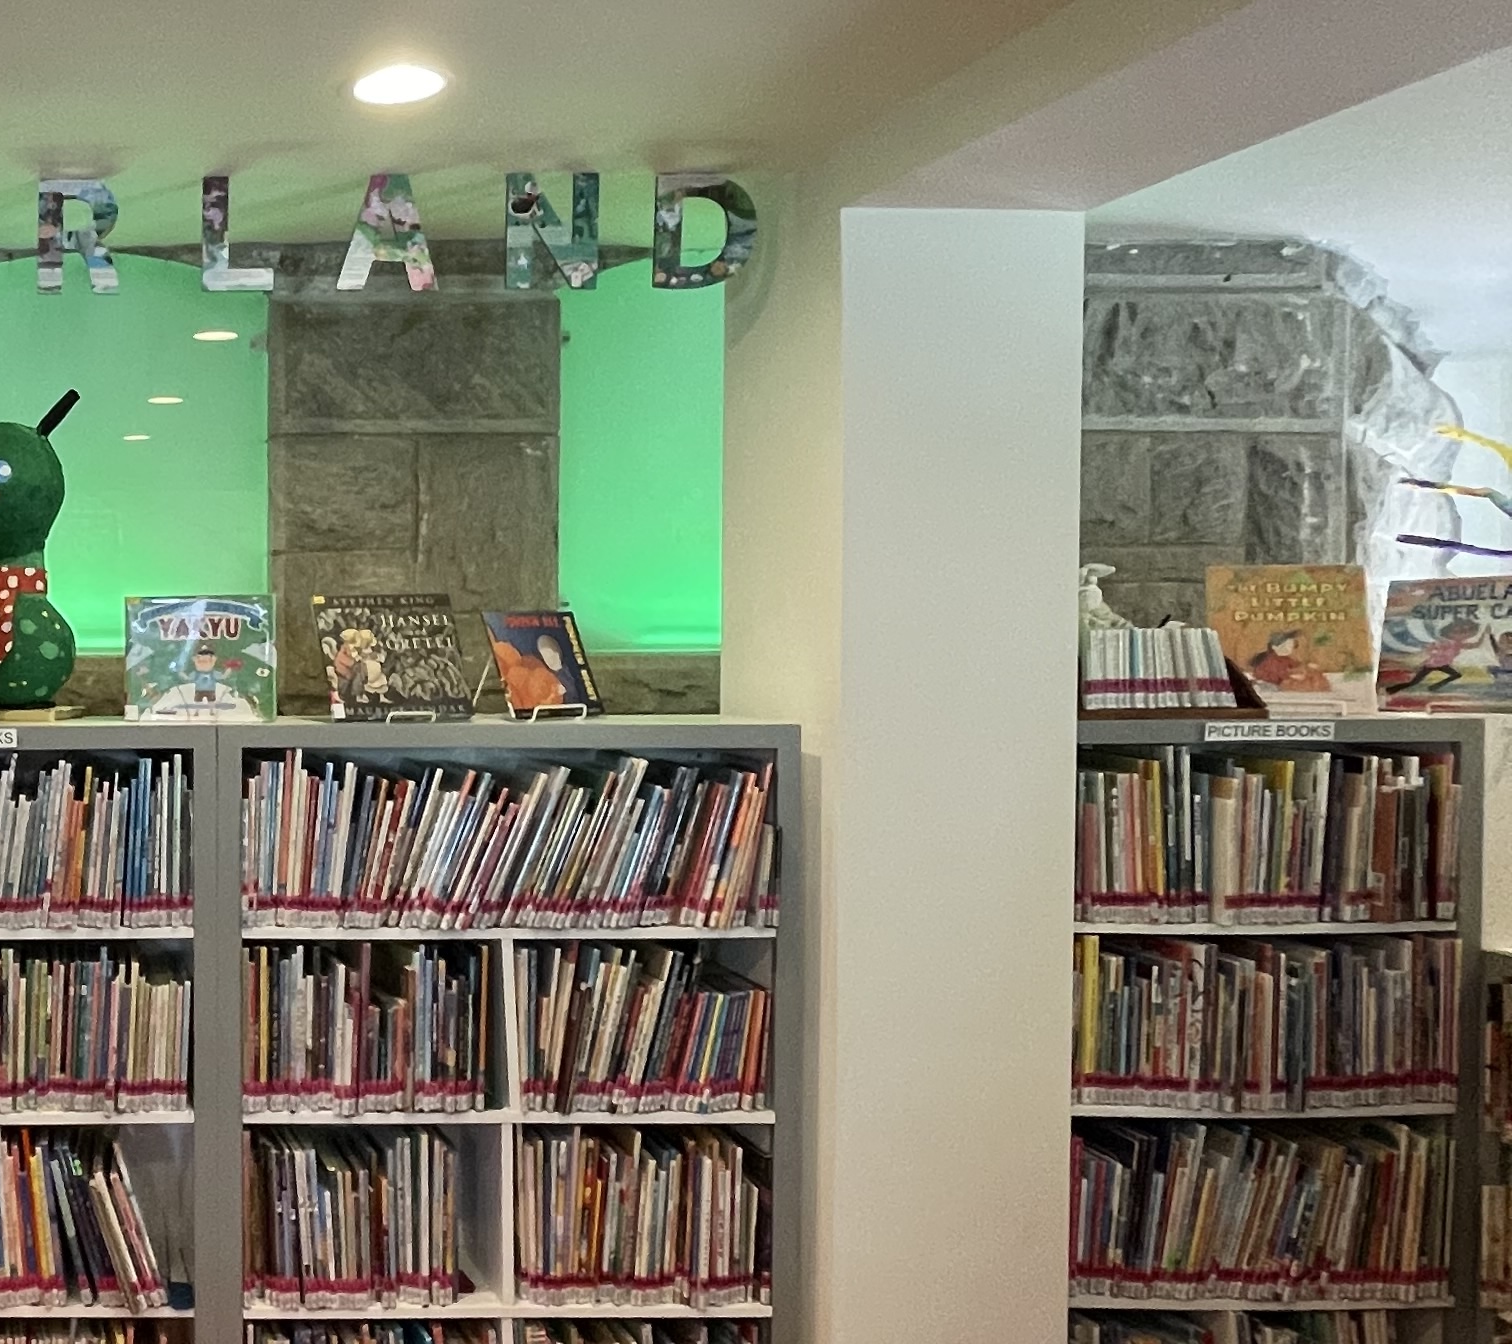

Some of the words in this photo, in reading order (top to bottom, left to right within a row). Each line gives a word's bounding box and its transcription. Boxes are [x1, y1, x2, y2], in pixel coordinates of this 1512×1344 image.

[1251, 597, 1327, 607] LITTLE
[1234, 611, 1346, 622] PUMPKIN
[1411, 604, 1480, 620] SUPER
[1207, 724, 1272, 738] PICTURE
[1275, 724, 1332, 737] BOOKS
